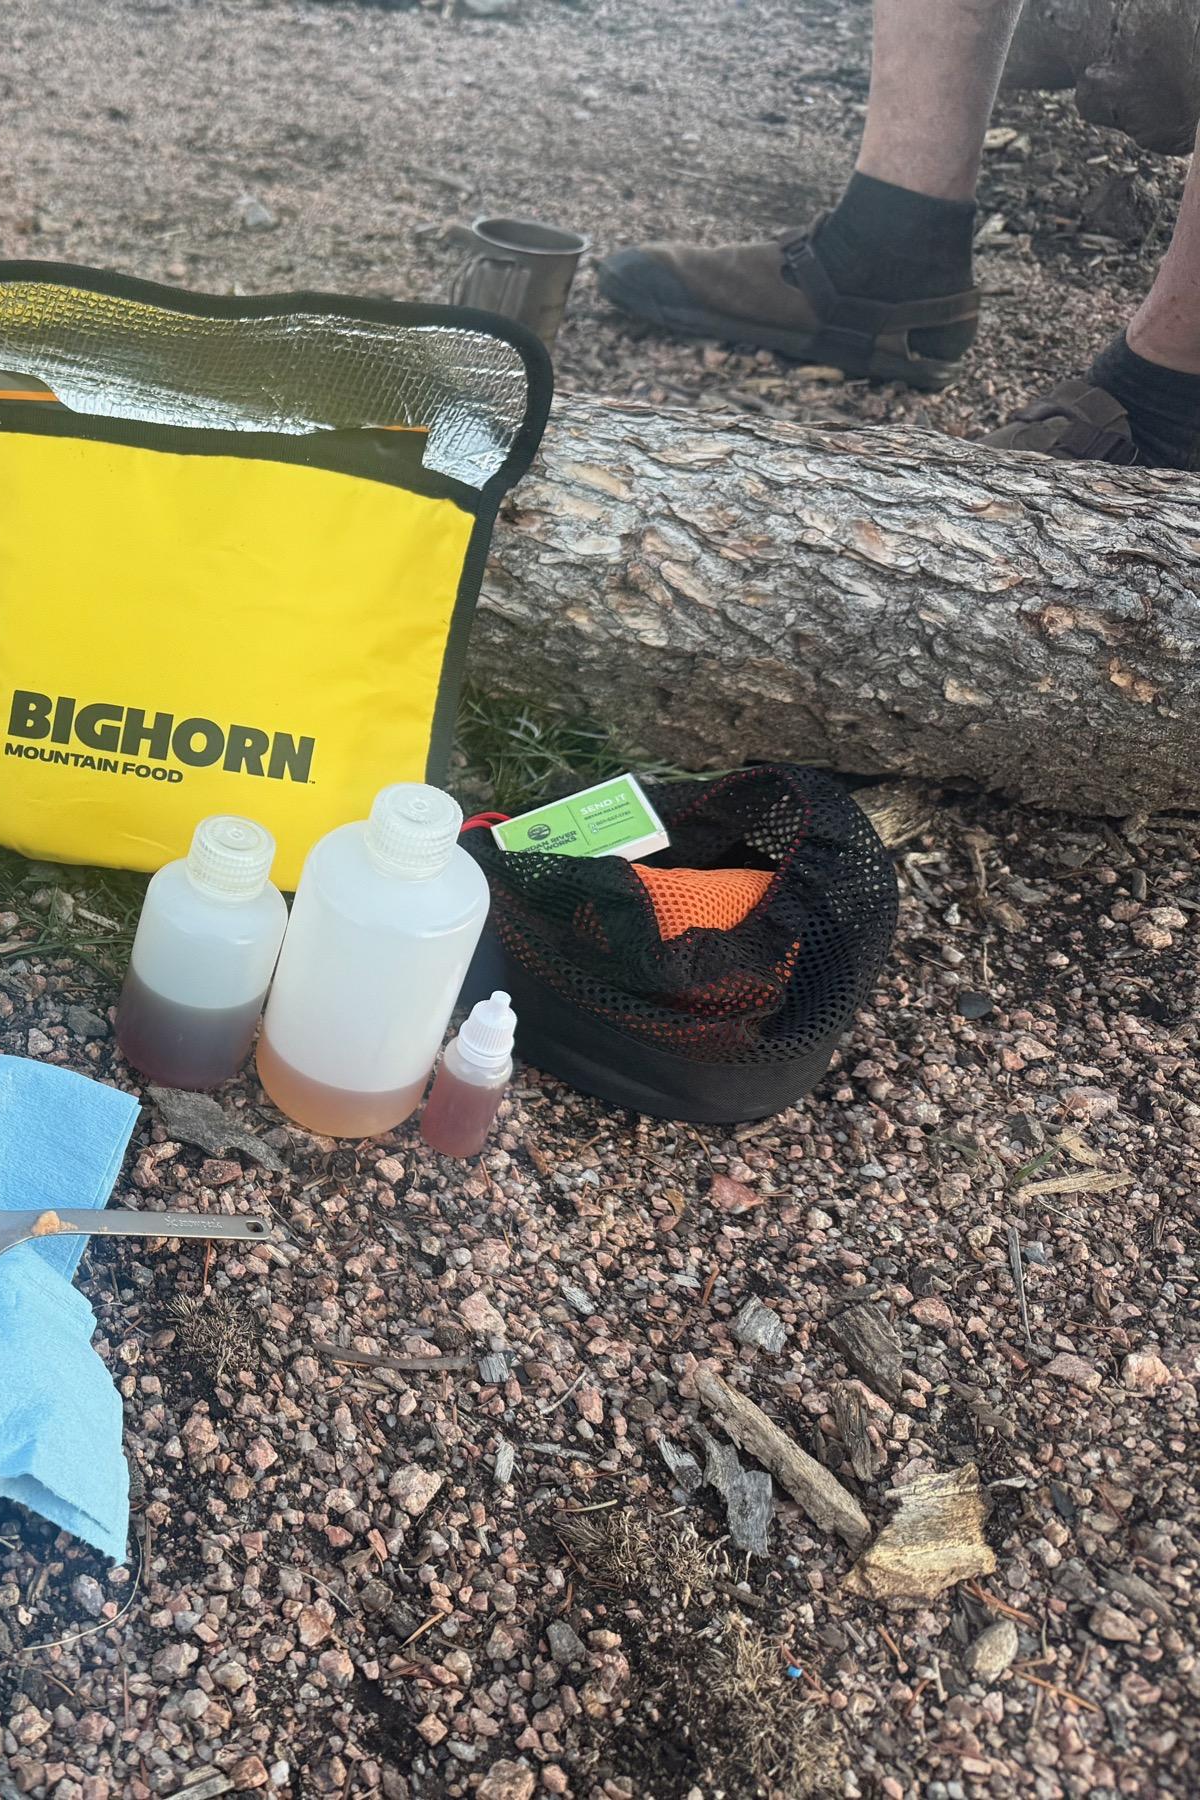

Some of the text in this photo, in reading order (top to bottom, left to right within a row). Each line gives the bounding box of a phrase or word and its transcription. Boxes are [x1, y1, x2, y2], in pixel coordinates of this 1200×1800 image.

[7, 689, 316, 784] BIGHORN
[4, 742, 184, 784] MOUNTAIN FOOD
[580, 798, 613, 815] SEND
[614, 792, 626, 804] IT
[519, 840, 550, 853] ORDAN
[550, 830, 577, 843] RIVER
[543, 835, 577, 851] WORKS
